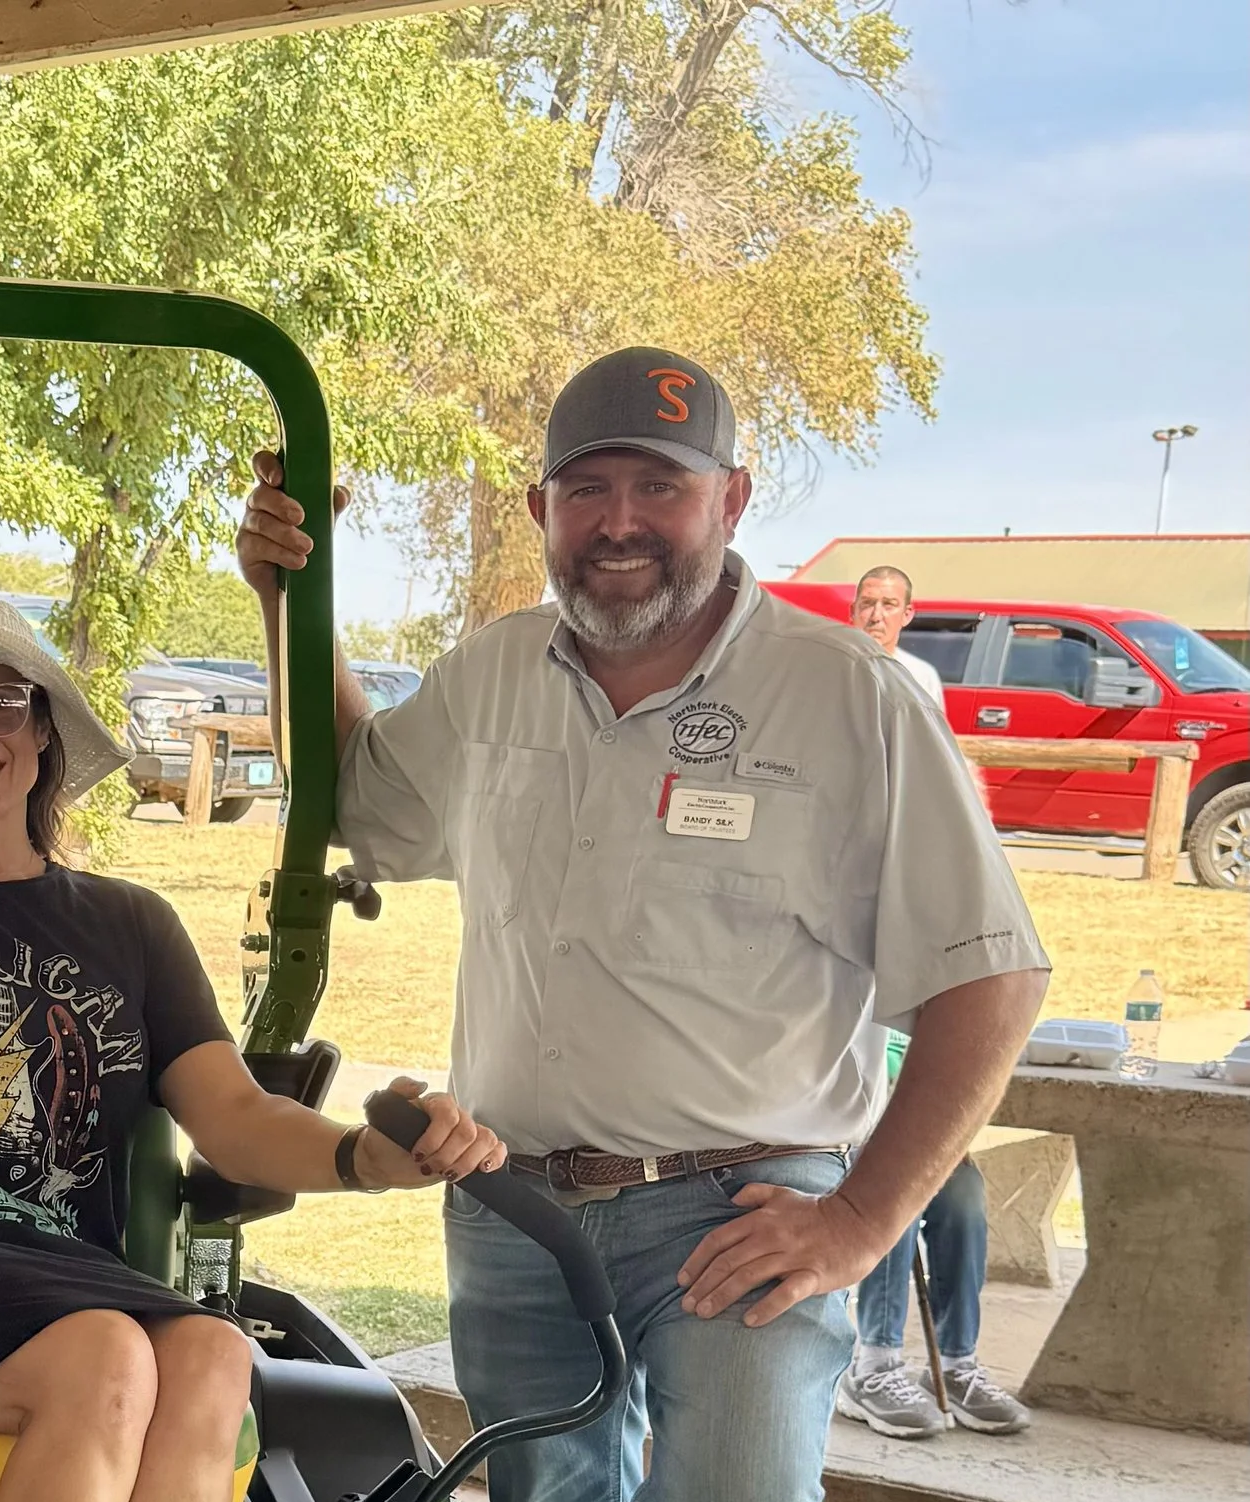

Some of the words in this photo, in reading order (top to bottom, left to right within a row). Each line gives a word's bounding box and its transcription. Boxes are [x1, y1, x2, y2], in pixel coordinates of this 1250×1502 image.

[667, 701, 718, 723] Northfork
[720, 704, 749, 732] Electric
[678, 716, 731, 747] nfec
[668, 746, 731, 765] Cooperative
